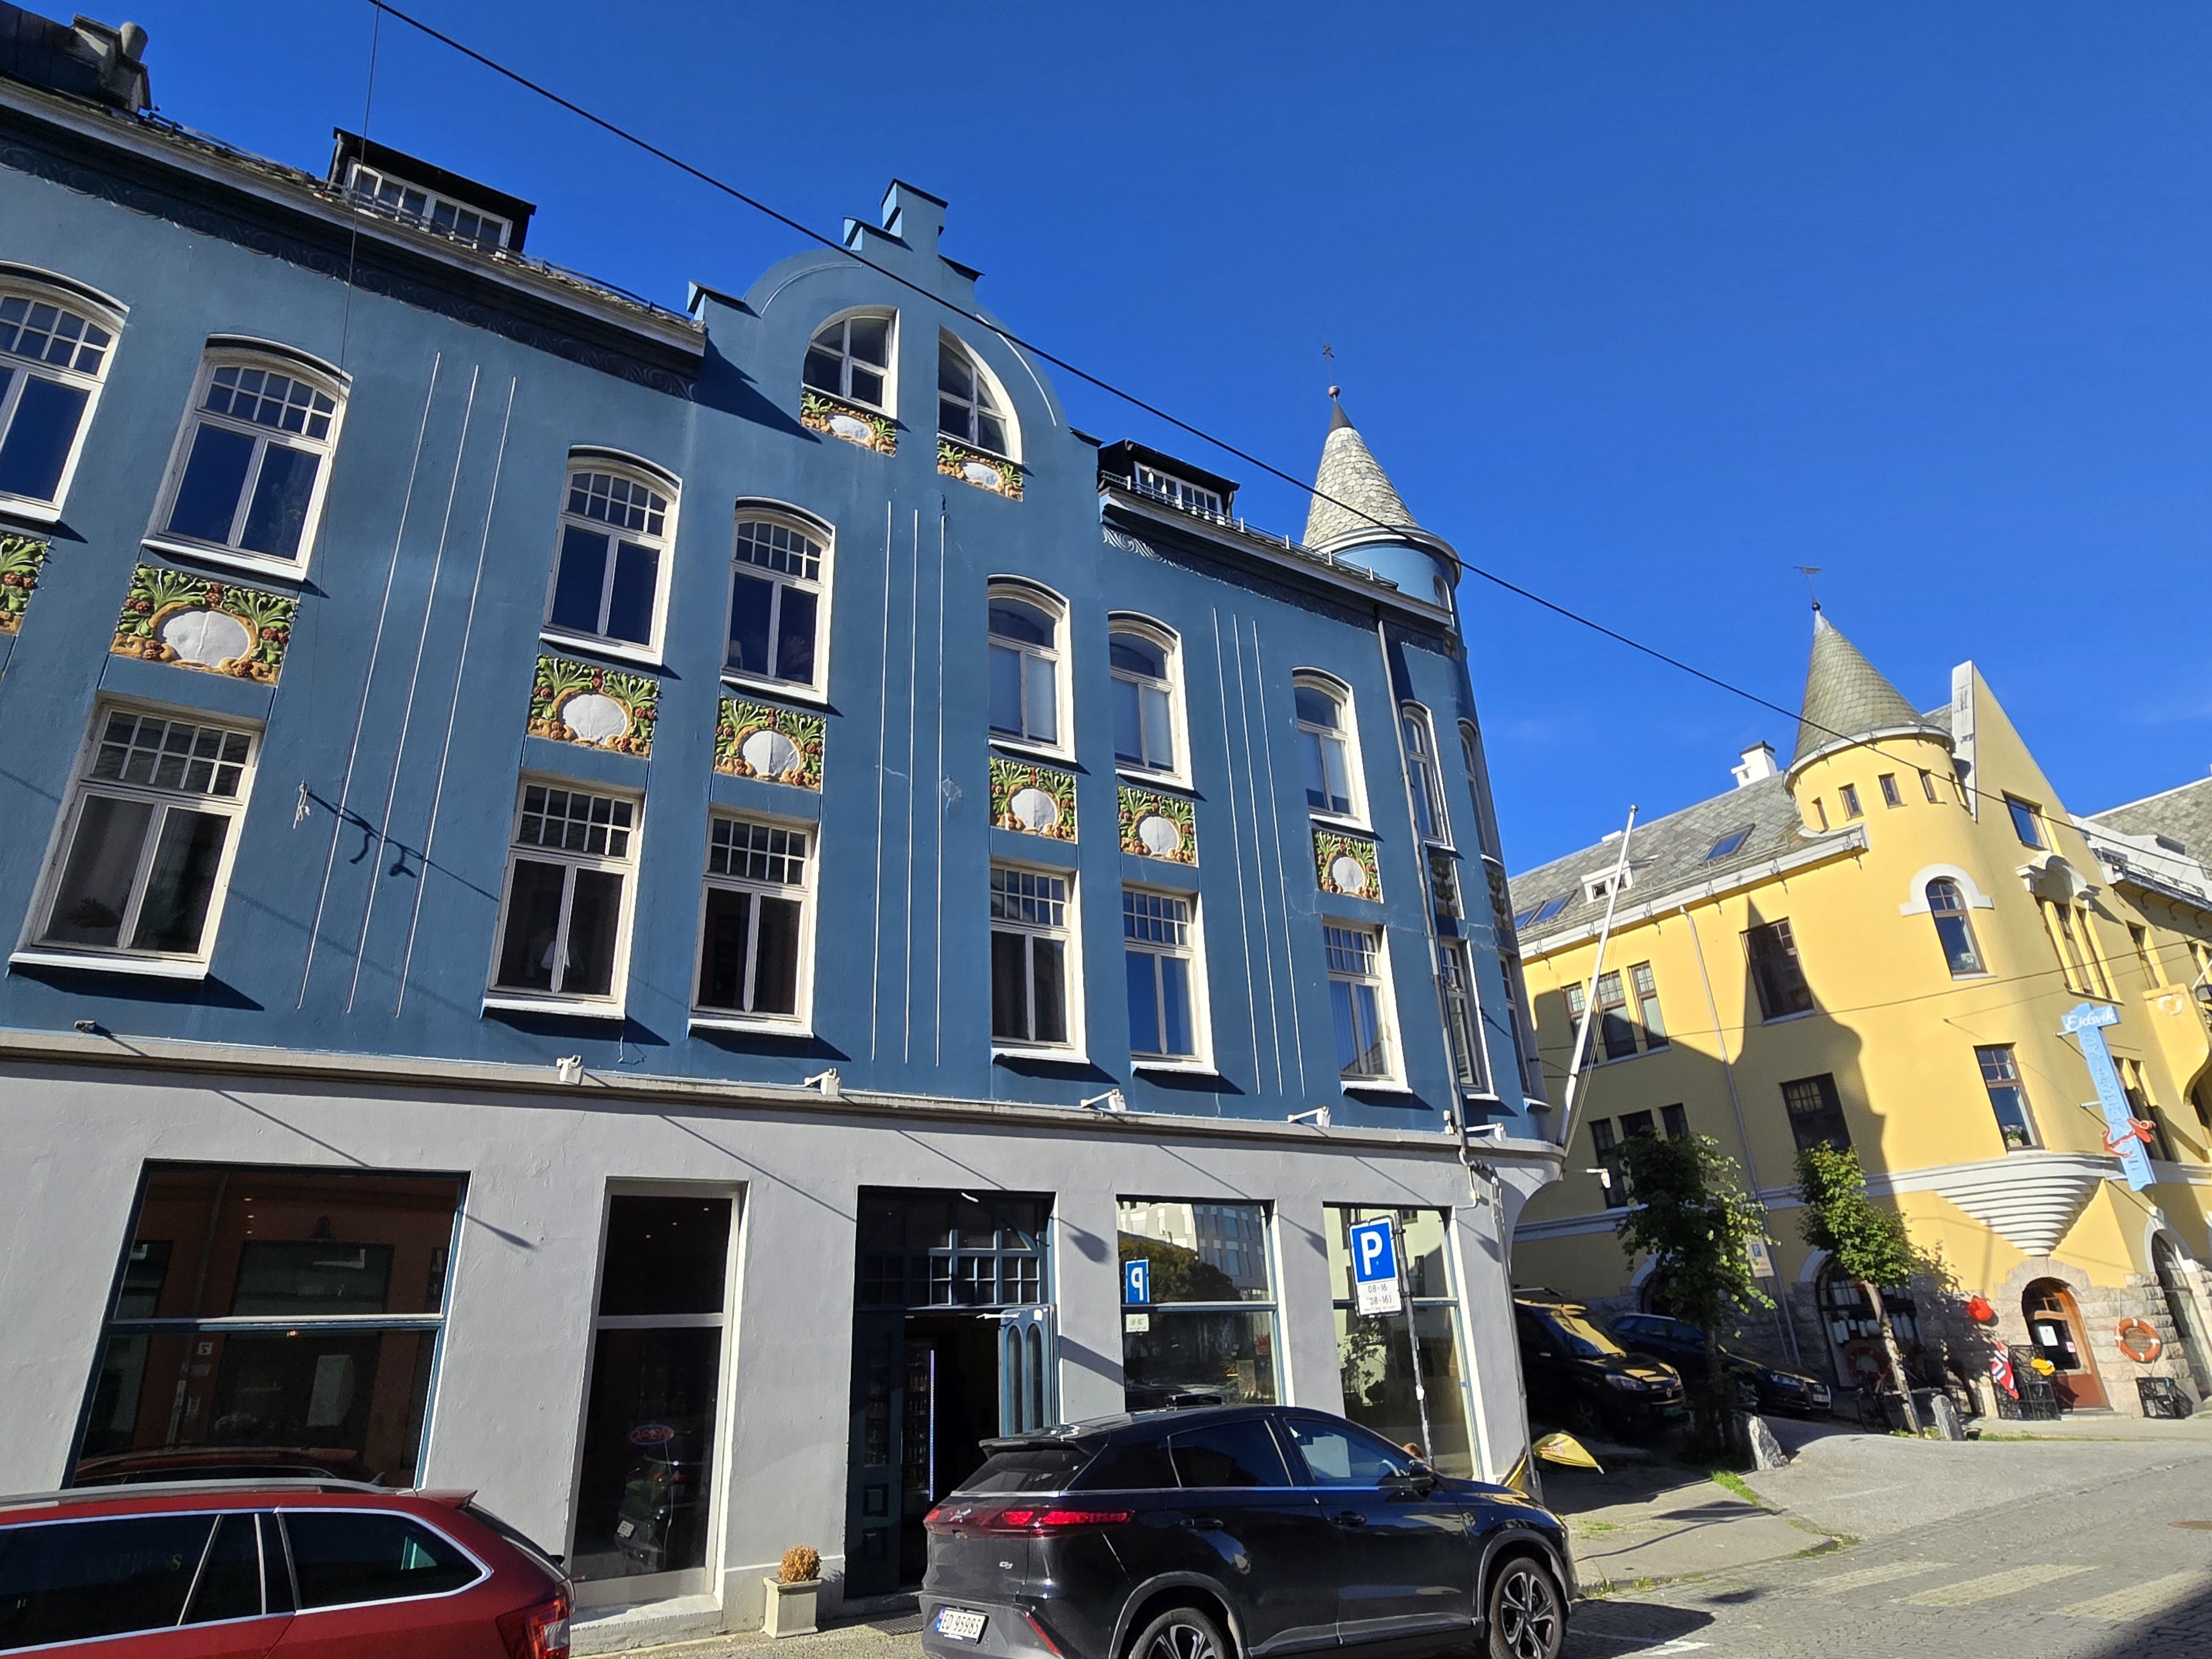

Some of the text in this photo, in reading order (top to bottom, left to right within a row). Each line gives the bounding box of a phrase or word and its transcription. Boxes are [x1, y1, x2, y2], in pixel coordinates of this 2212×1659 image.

[2065, 1008, 2115, 1031] Eidsvik
[1360, 1231, 1383, 1275] P
[1368, 1283, 1387, 1293] 08-16
[1366, 1294, 1392, 1305] 08-16)
[942, 1614, 980, 1635] ED 95985
